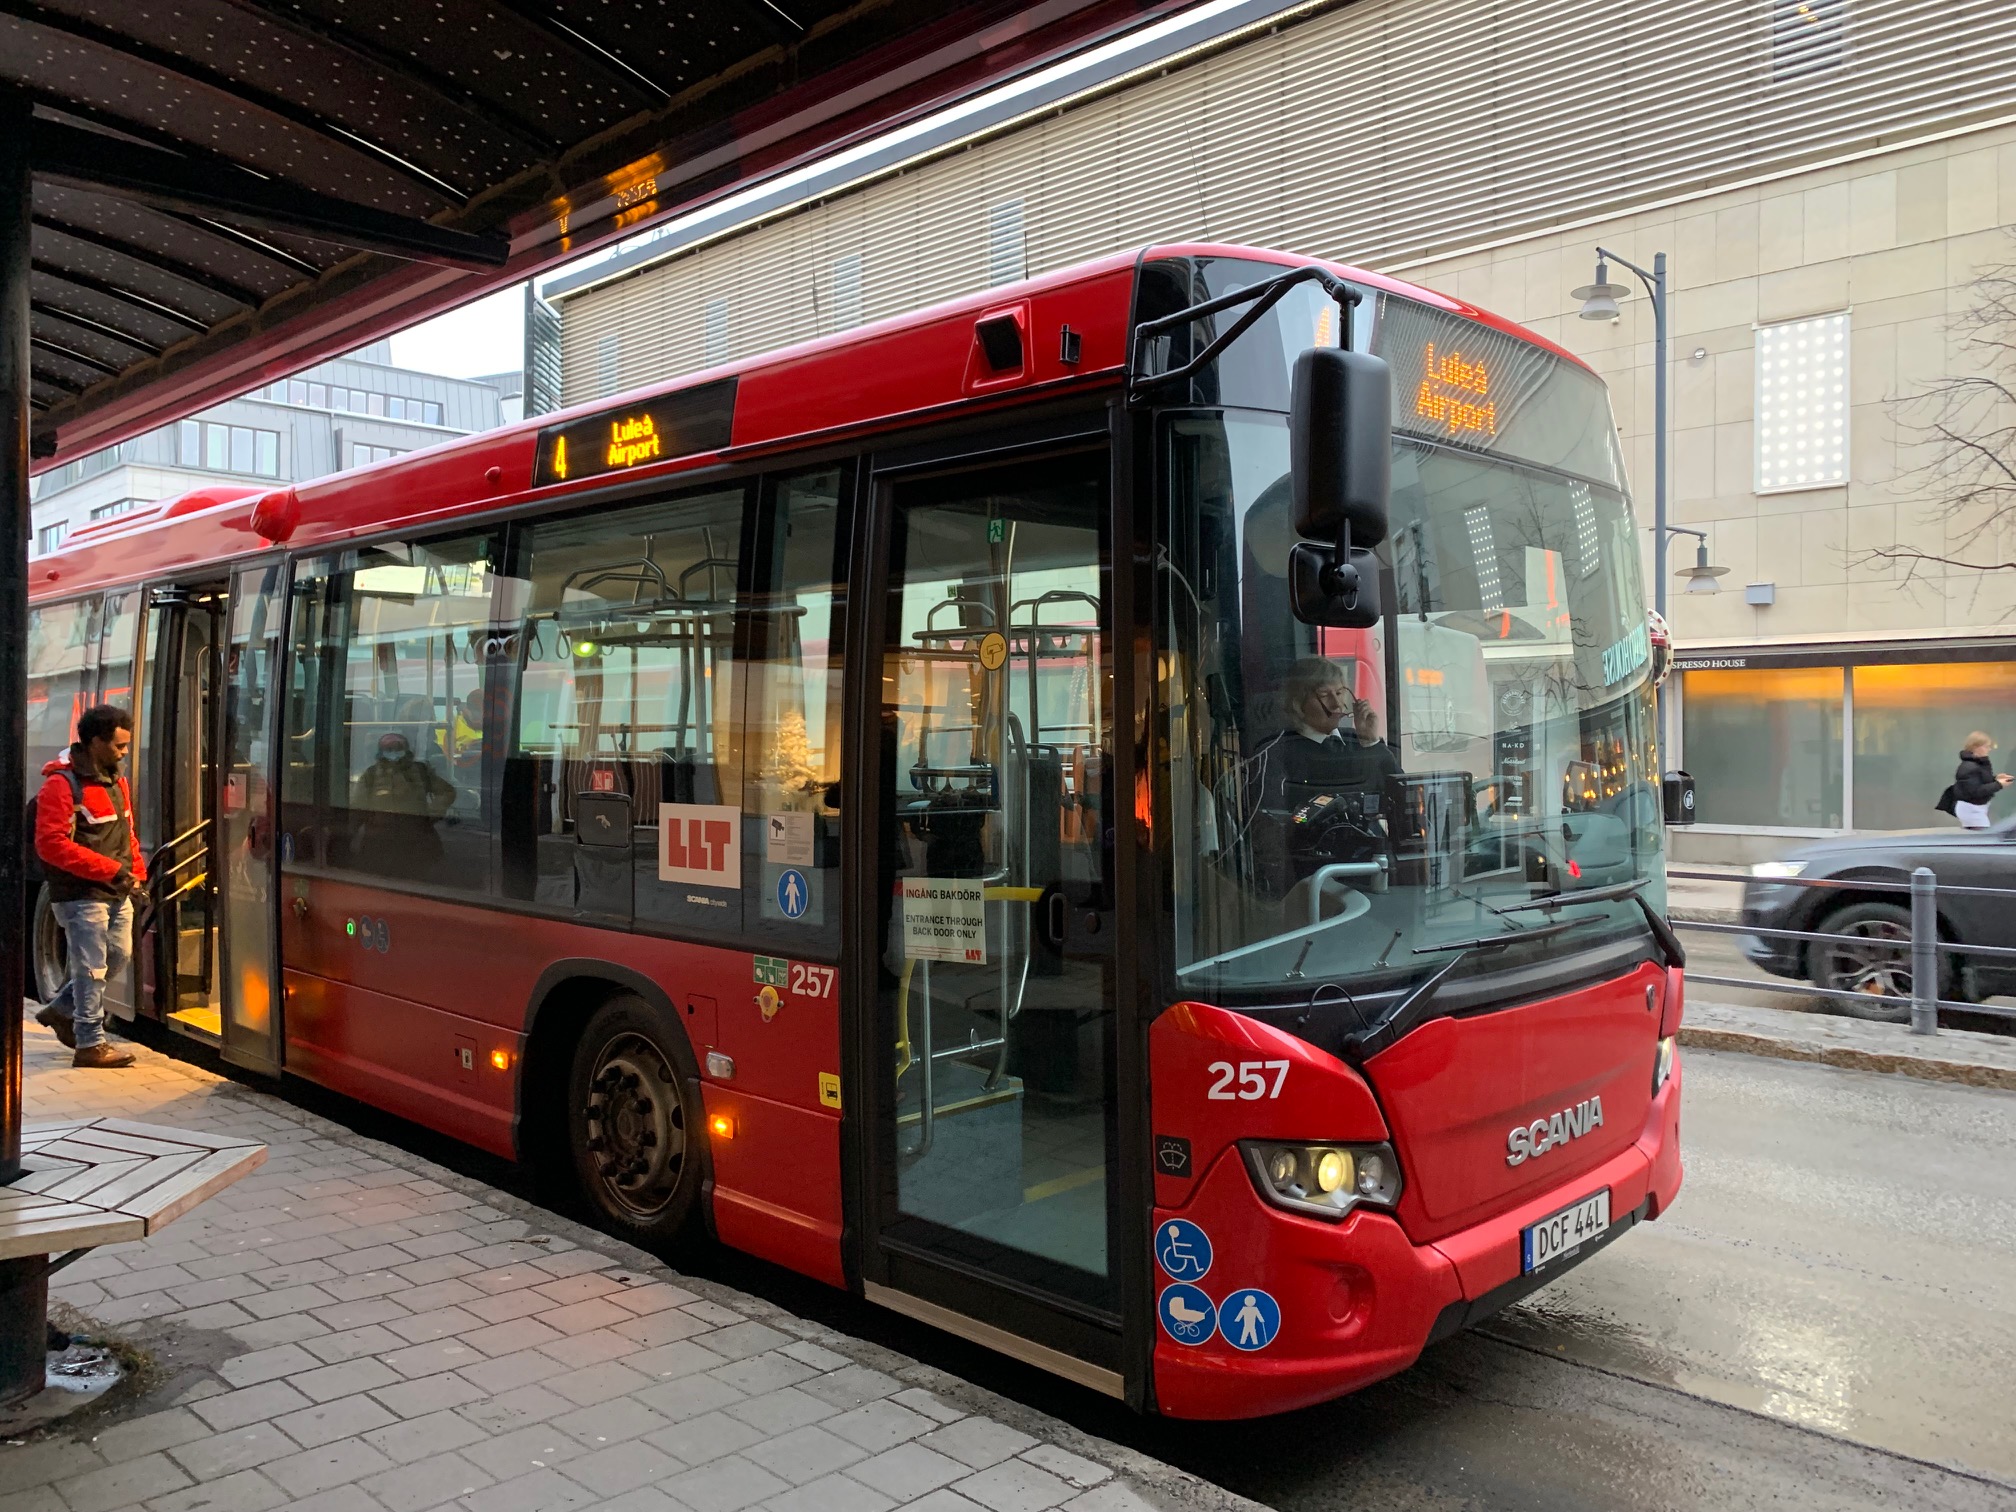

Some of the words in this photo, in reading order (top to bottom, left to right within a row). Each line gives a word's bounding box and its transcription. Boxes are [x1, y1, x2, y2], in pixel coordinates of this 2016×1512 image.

[1427, 342, 1488, 394] Luleå
[1416, 380, 1496, 435] Airport
[611, 413, 654, 443] Luleå
[554, 435, 567, 479] 4
[607, 434, 660, 467] Airport
[1671, 660, 1710, 669] SPRESSO
[1711, 659, 1746, 668] HOUSE
[668, 818, 731, 872] LLT
[906, 888, 938, 899] INGÅNG
[940, 889, 981, 901] BAKDÖRR
[905, 914, 945, 925] ENTRANCE
[945, 916, 983, 927] THROUGH
[912, 926, 932, 936] BACK
[933, 928, 955, 937] DOOR
[956, 929, 977, 939] ONLY
[791, 964, 834, 999] 257
[1207, 1059, 1290, 1100] 257
[1506, 1095, 1604, 1167] SCANIA
[1539, 1214, 1569, 1260] DCF
[1574, 1200, 1604, 1238] 44L
